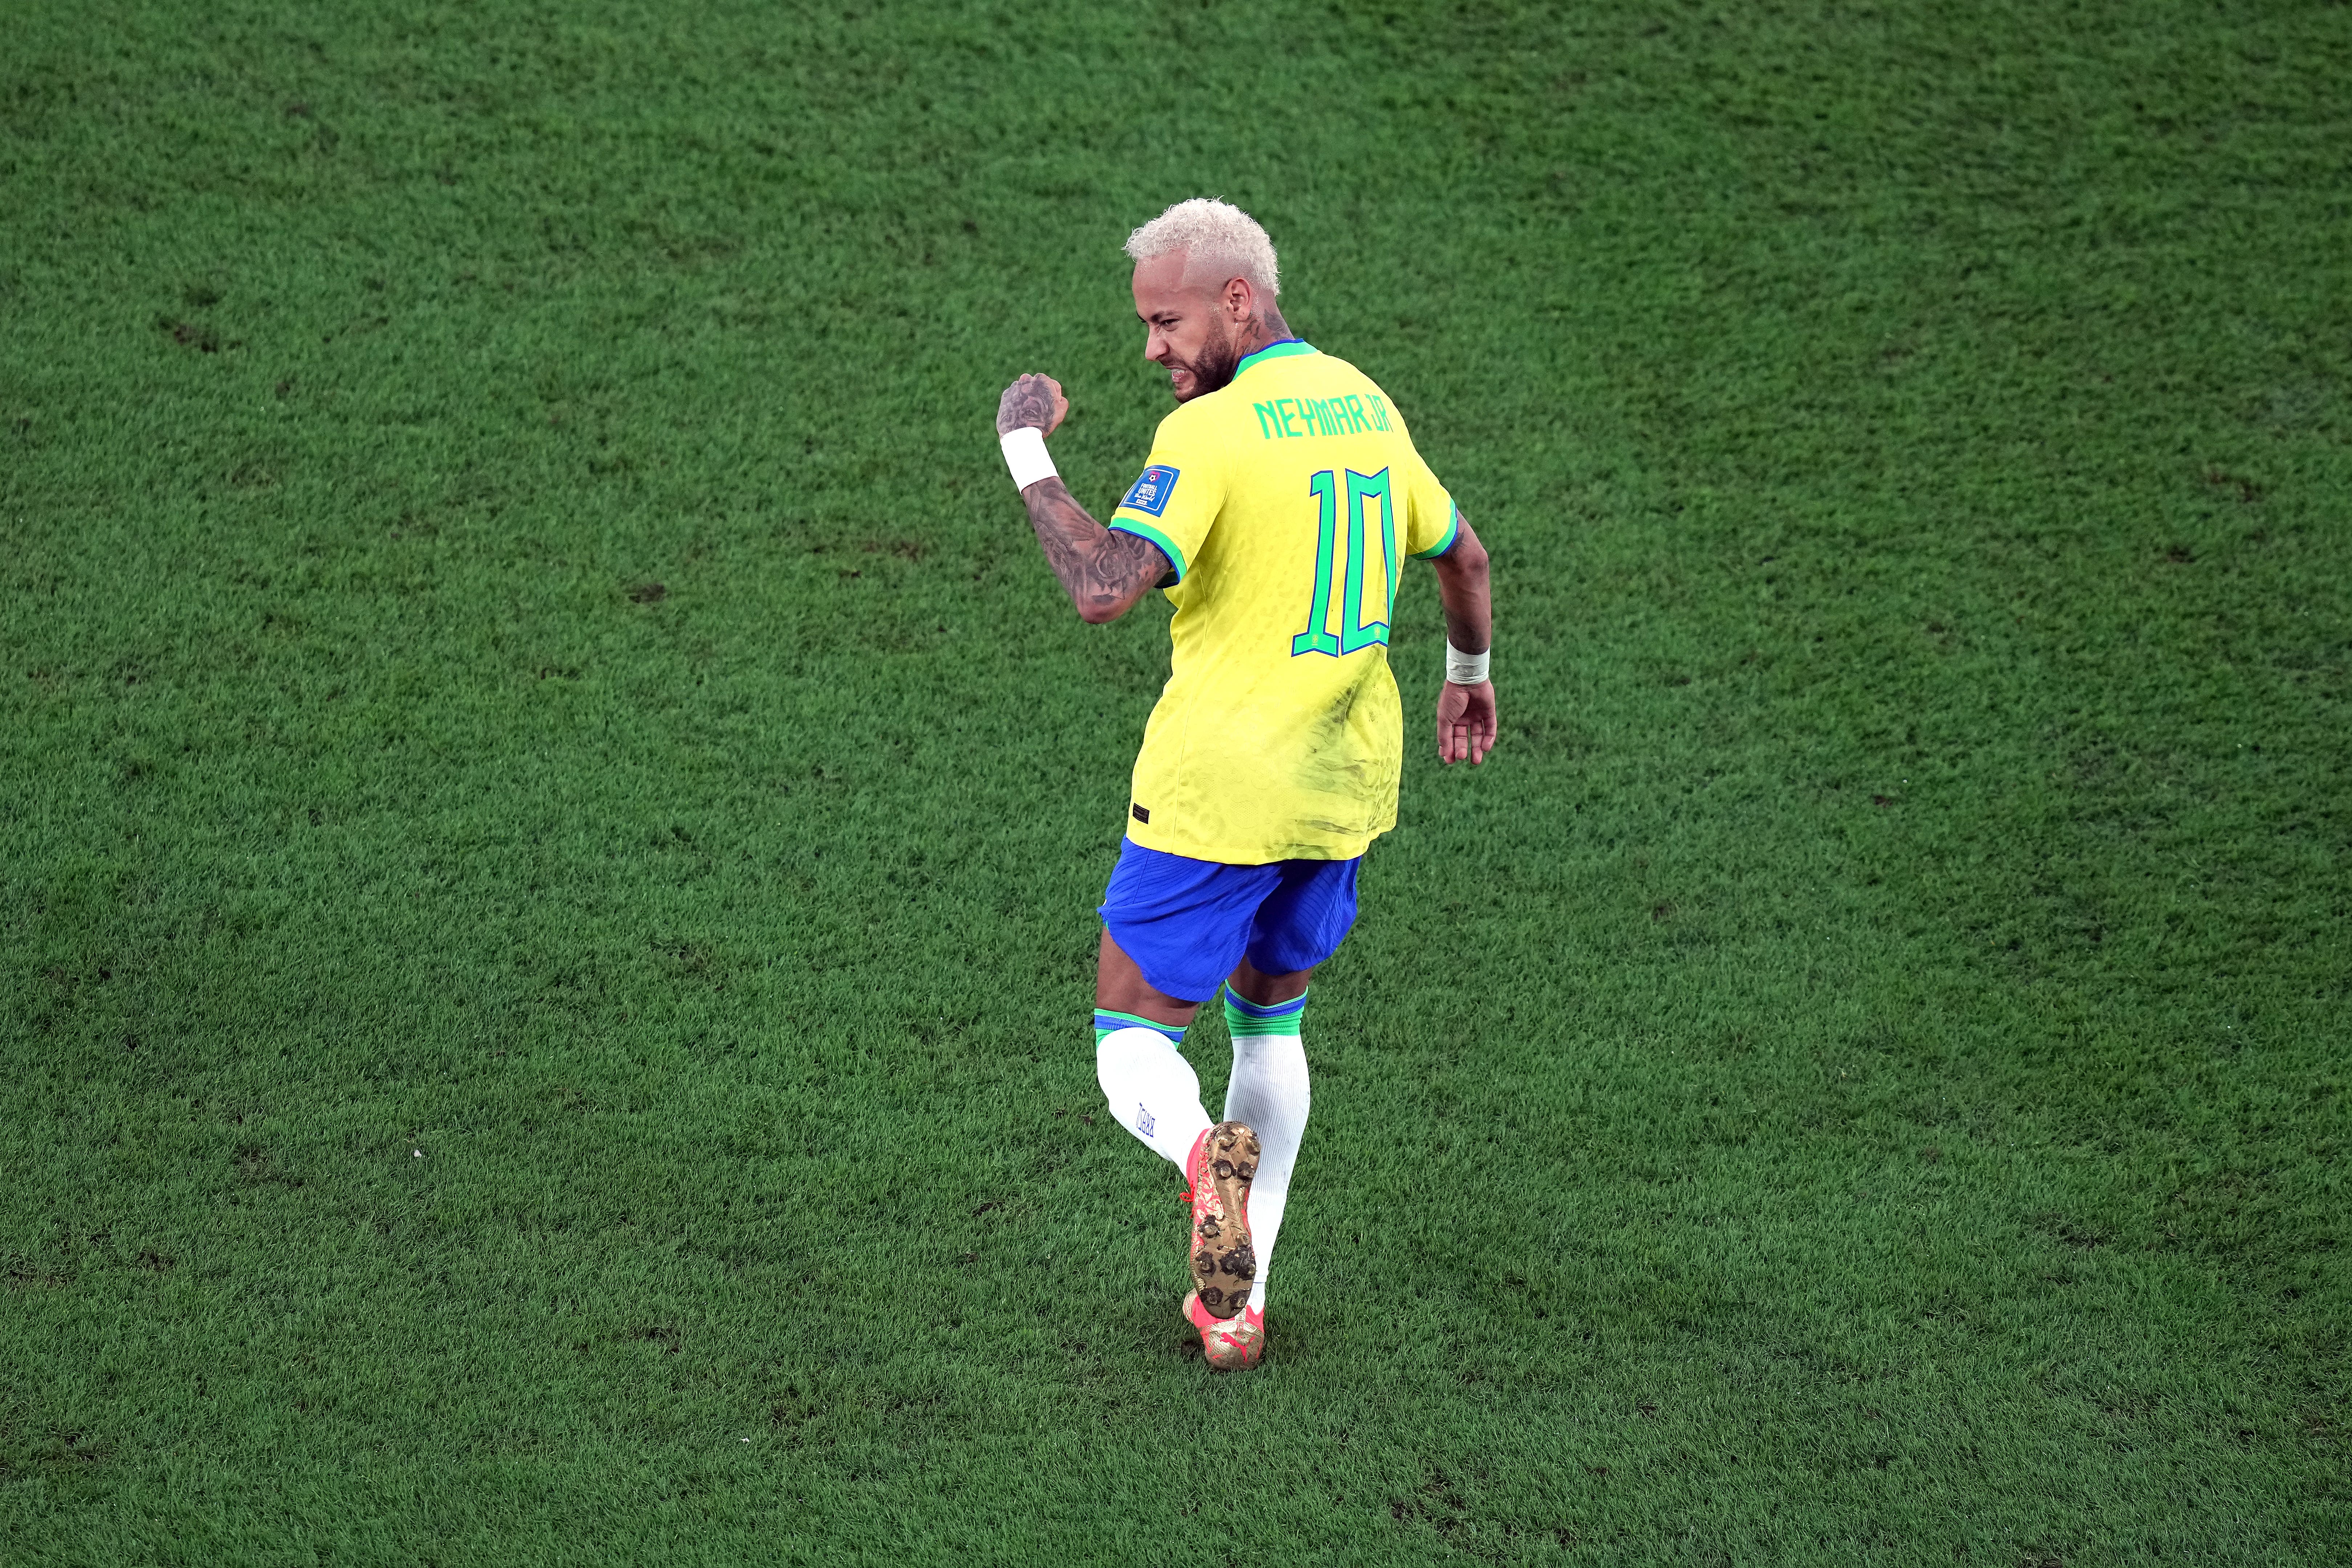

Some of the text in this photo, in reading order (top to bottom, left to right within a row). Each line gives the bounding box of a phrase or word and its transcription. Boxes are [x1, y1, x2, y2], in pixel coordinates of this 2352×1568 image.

[1252, 394, 1393, 439] NEYMAR JR
[1138, 487, 1156, 497] UNITES
[1291, 466, 1396, 657] 10
